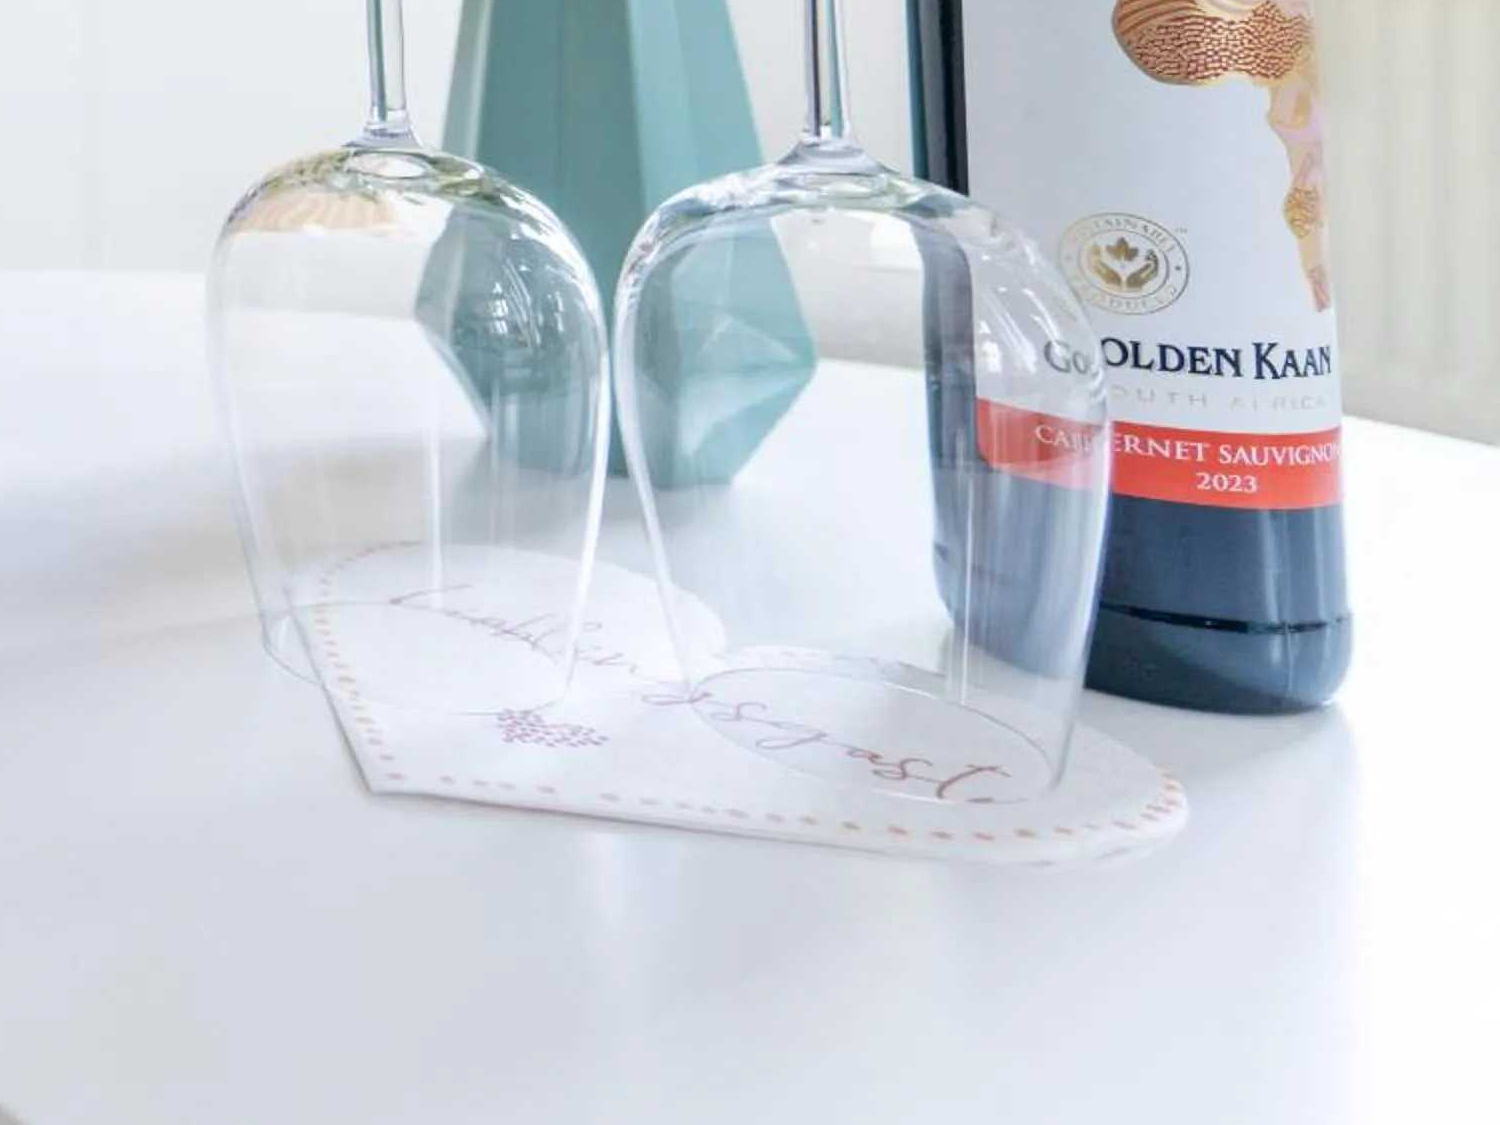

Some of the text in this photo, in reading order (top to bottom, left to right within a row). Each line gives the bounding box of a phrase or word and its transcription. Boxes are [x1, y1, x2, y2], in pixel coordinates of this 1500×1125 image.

[1253, 341, 1332, 381] KAAN
[1111, 385, 1207, 408] OUTH
[1195, 471, 1259, 494] 2023
